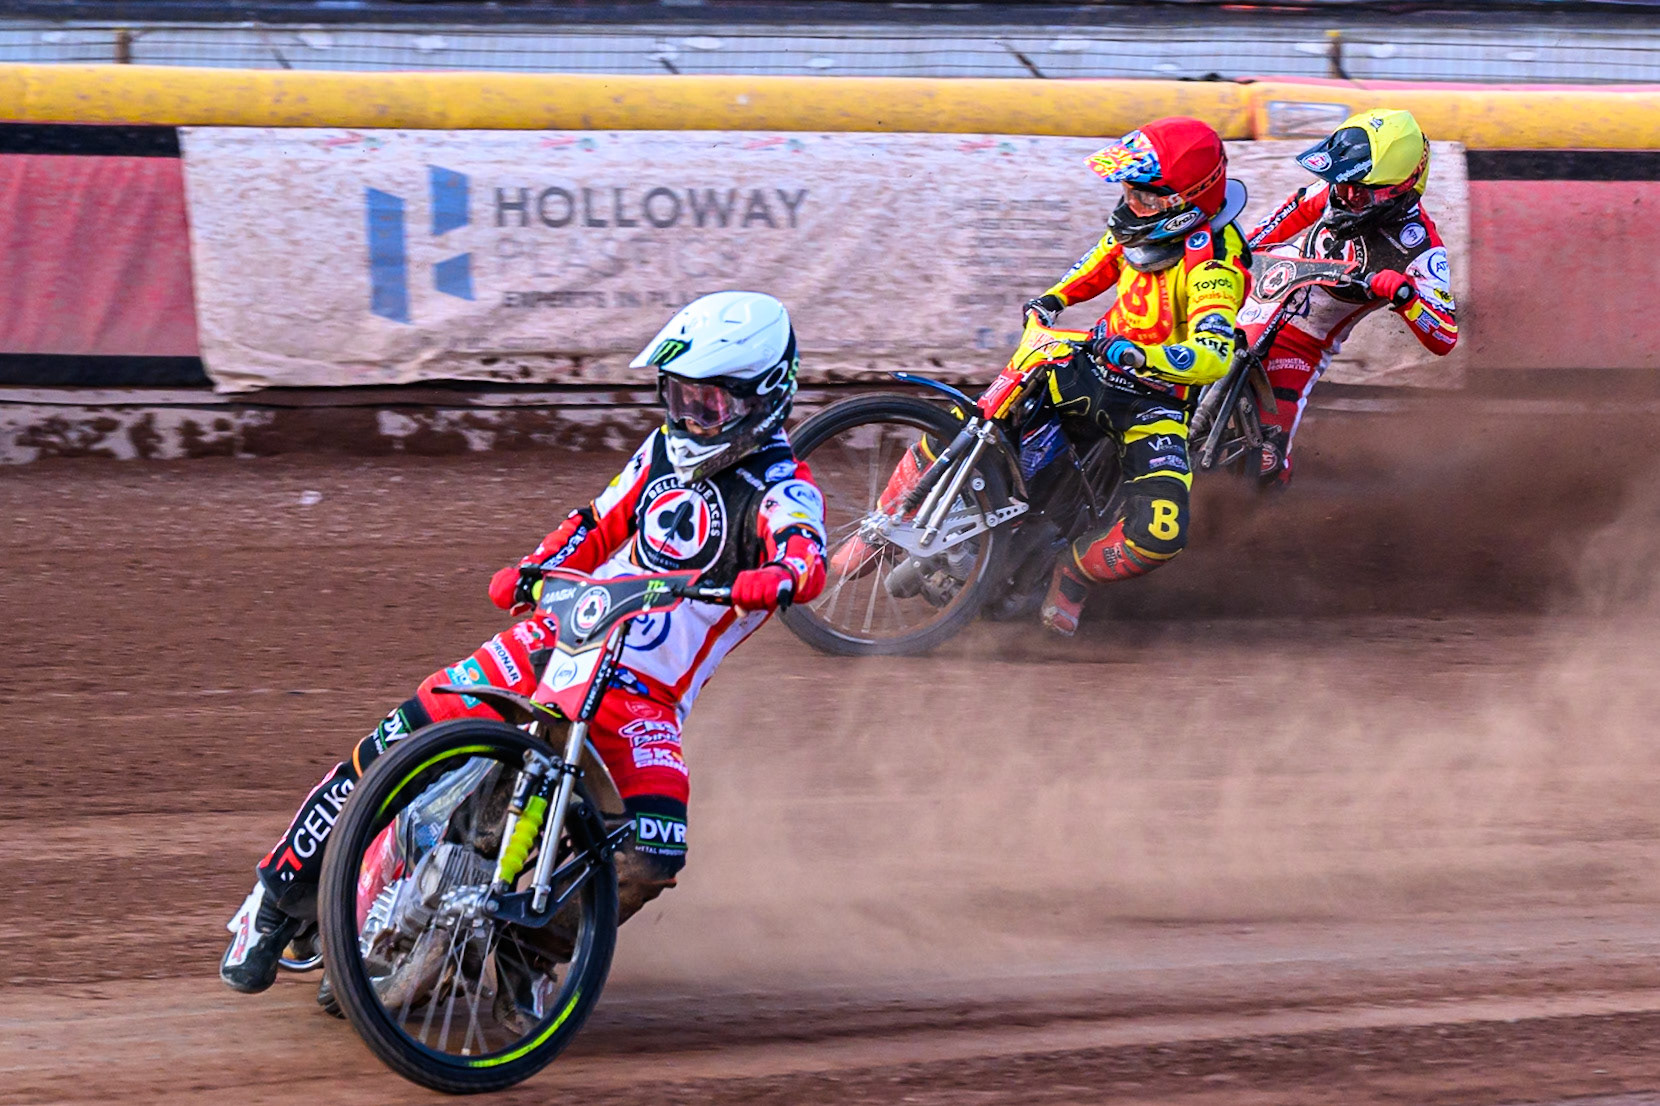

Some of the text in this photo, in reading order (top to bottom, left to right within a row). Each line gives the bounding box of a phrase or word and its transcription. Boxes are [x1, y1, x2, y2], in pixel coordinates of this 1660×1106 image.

[494, 186, 808, 229] HOLLOWAY
[1168, 213, 1197, 229] Arai
[648, 479, 686, 499] BELLE
[709, 503, 721, 537] ACES
[1148, 499, 1180, 540] B
[384, 713, 410, 742] DV
[640, 817, 687, 843] DVR
